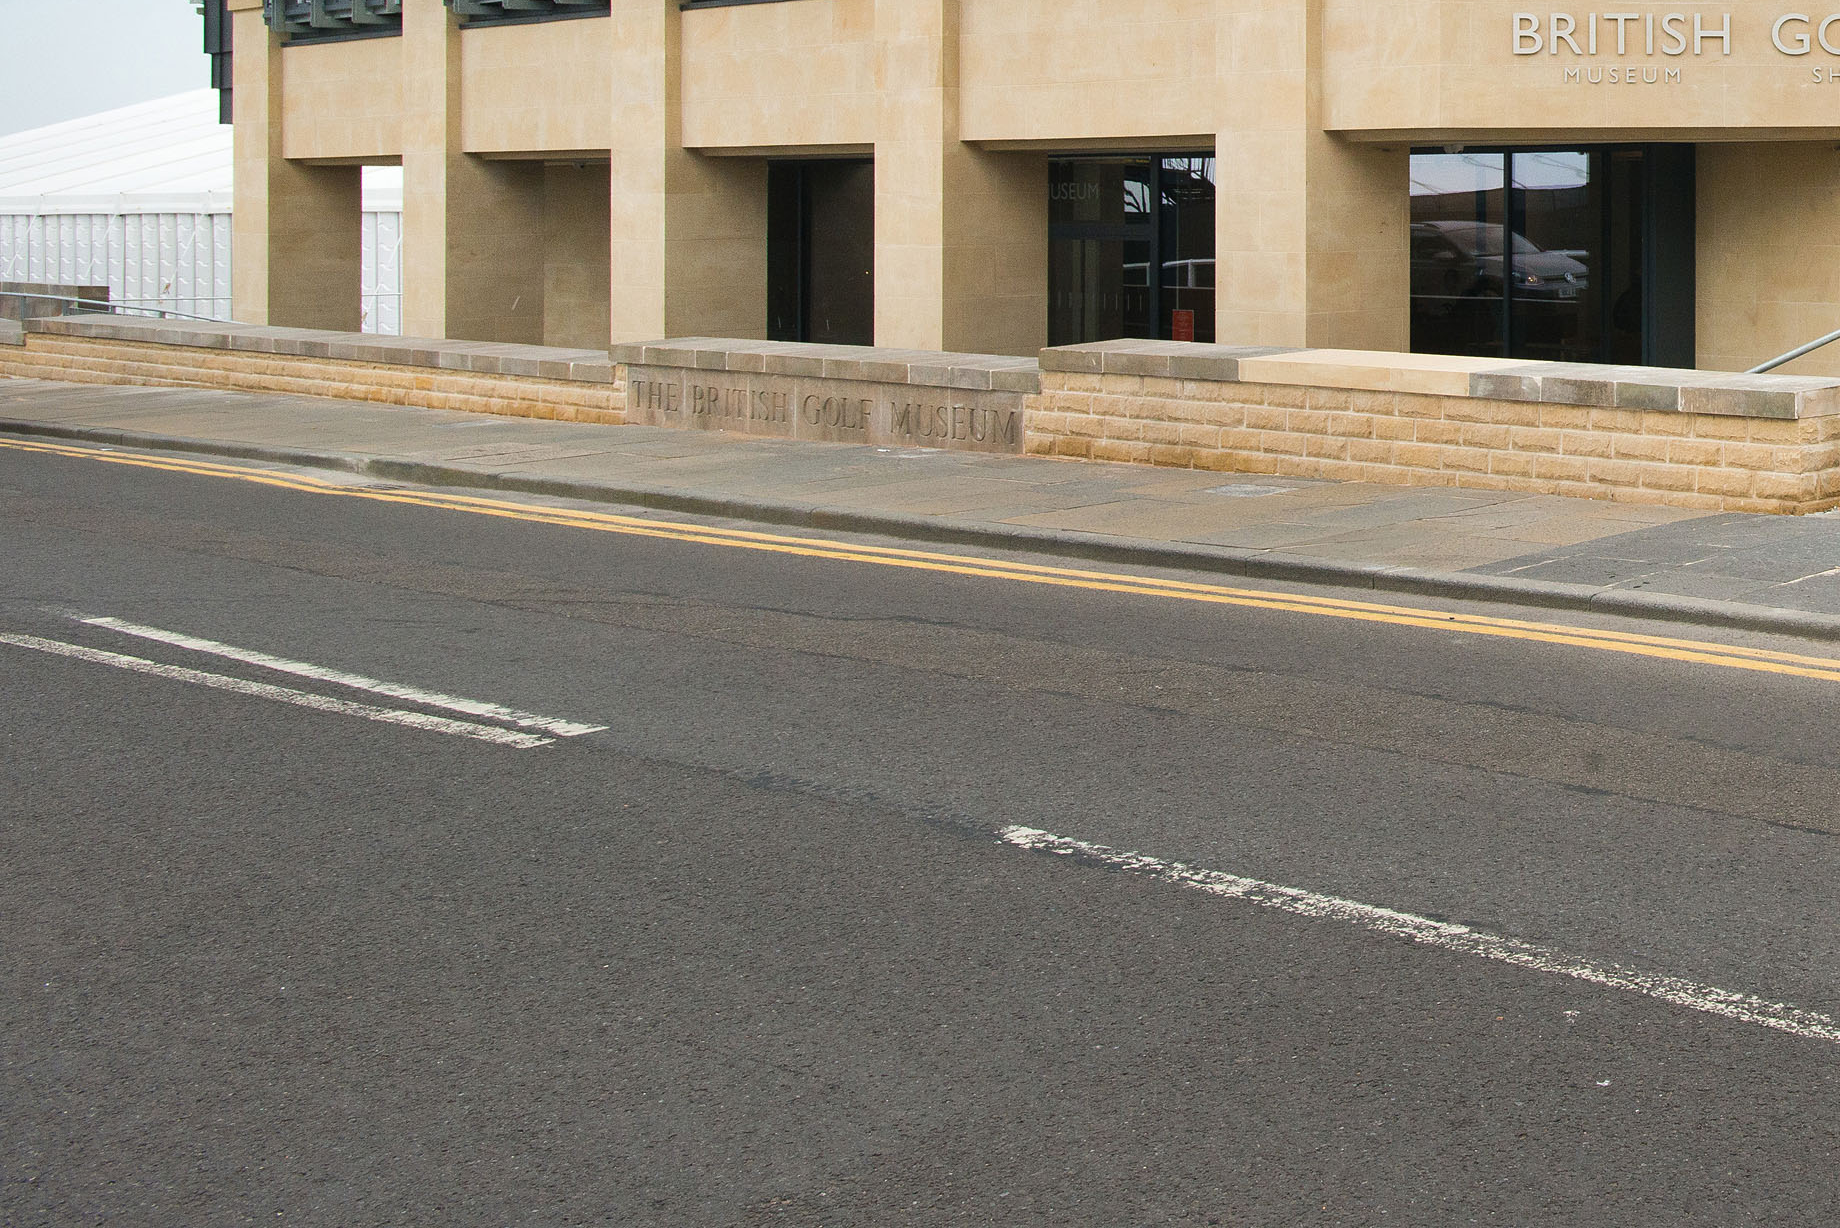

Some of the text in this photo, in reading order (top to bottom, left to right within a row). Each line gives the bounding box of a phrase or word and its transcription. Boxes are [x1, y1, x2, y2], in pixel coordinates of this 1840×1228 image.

[1511, 12, 1731, 56] BRITISH
[1564, 67, 1683, 84] MUSEUM
[632, 380, 1018, 445] THE BRITISH GOLF MUSEUM
